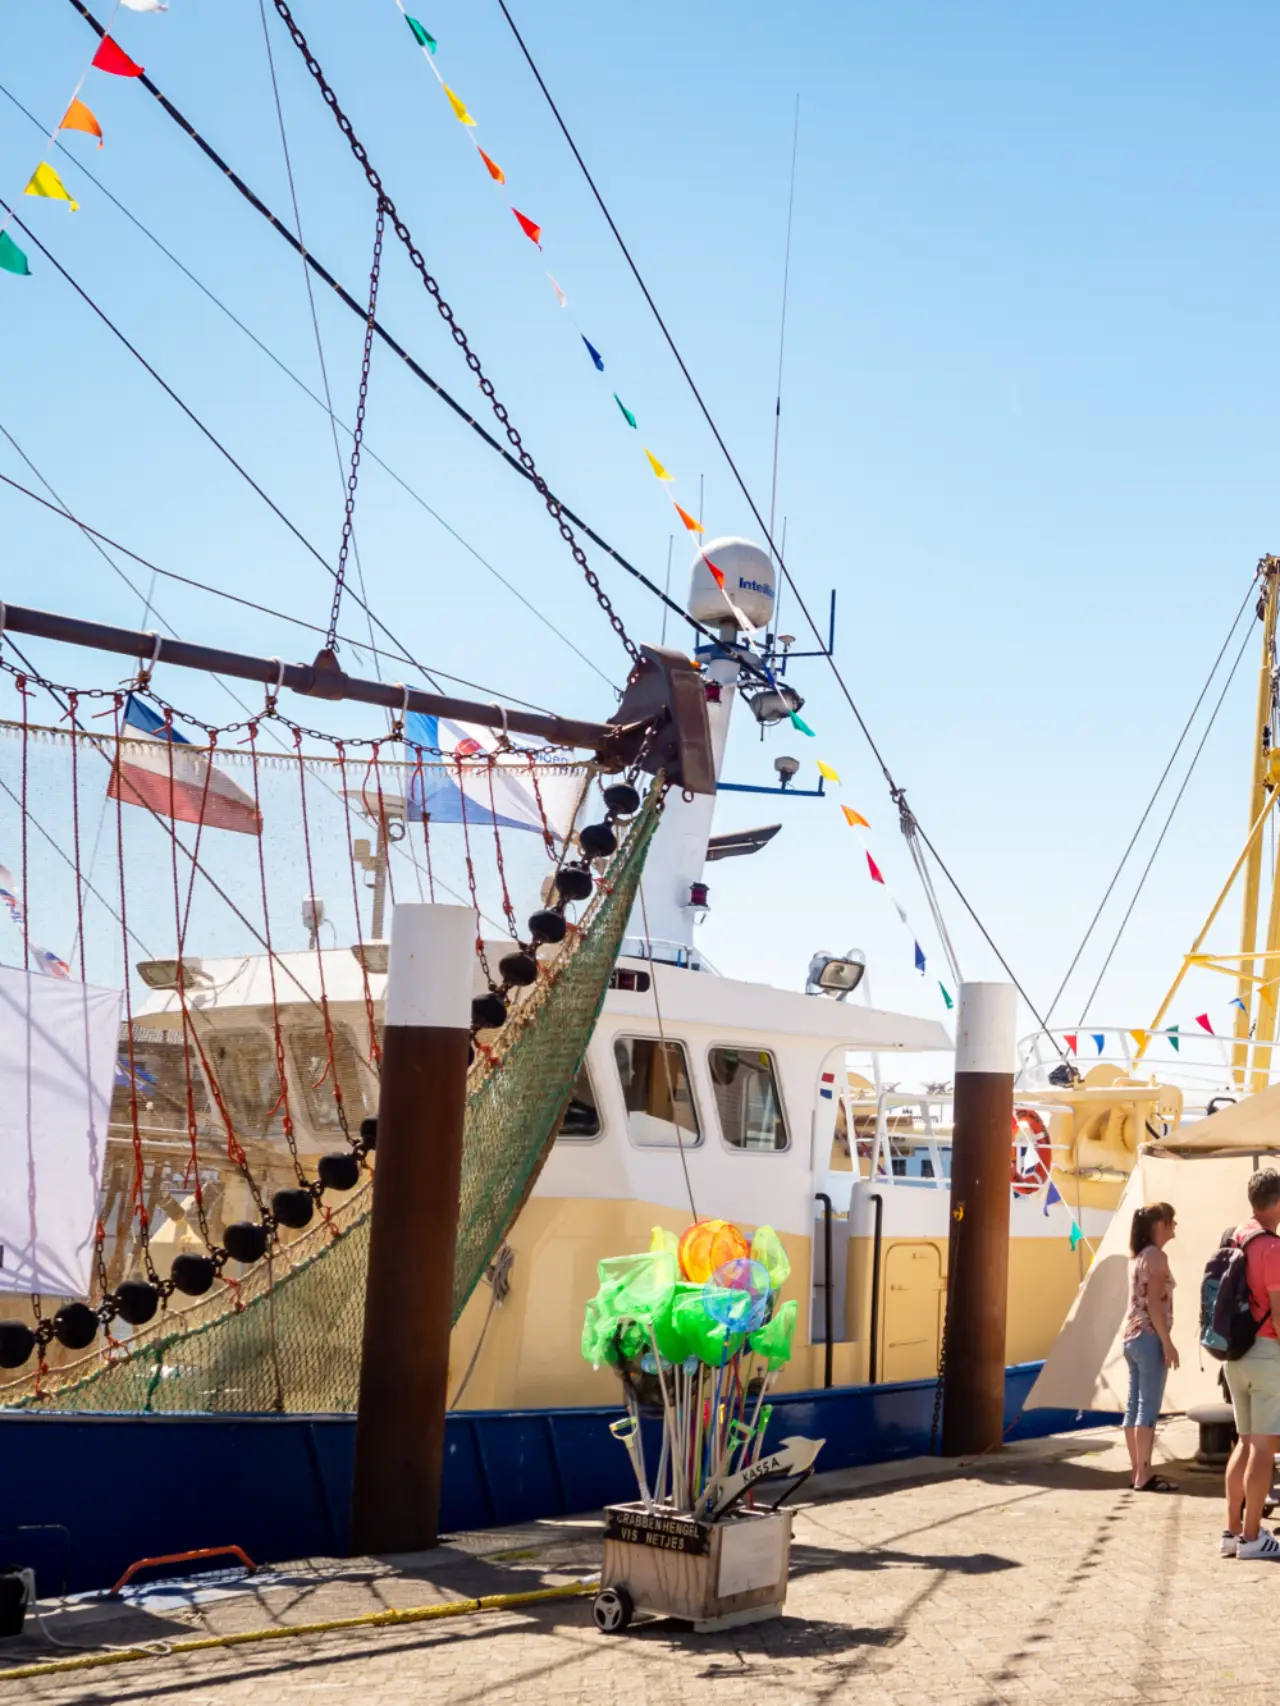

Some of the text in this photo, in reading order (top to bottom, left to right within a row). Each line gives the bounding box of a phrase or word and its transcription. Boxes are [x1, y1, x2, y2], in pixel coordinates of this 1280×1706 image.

[742, 1457, 781, 1485] KASSA
[621, 1527, 685, 1550] VIS NETJES
